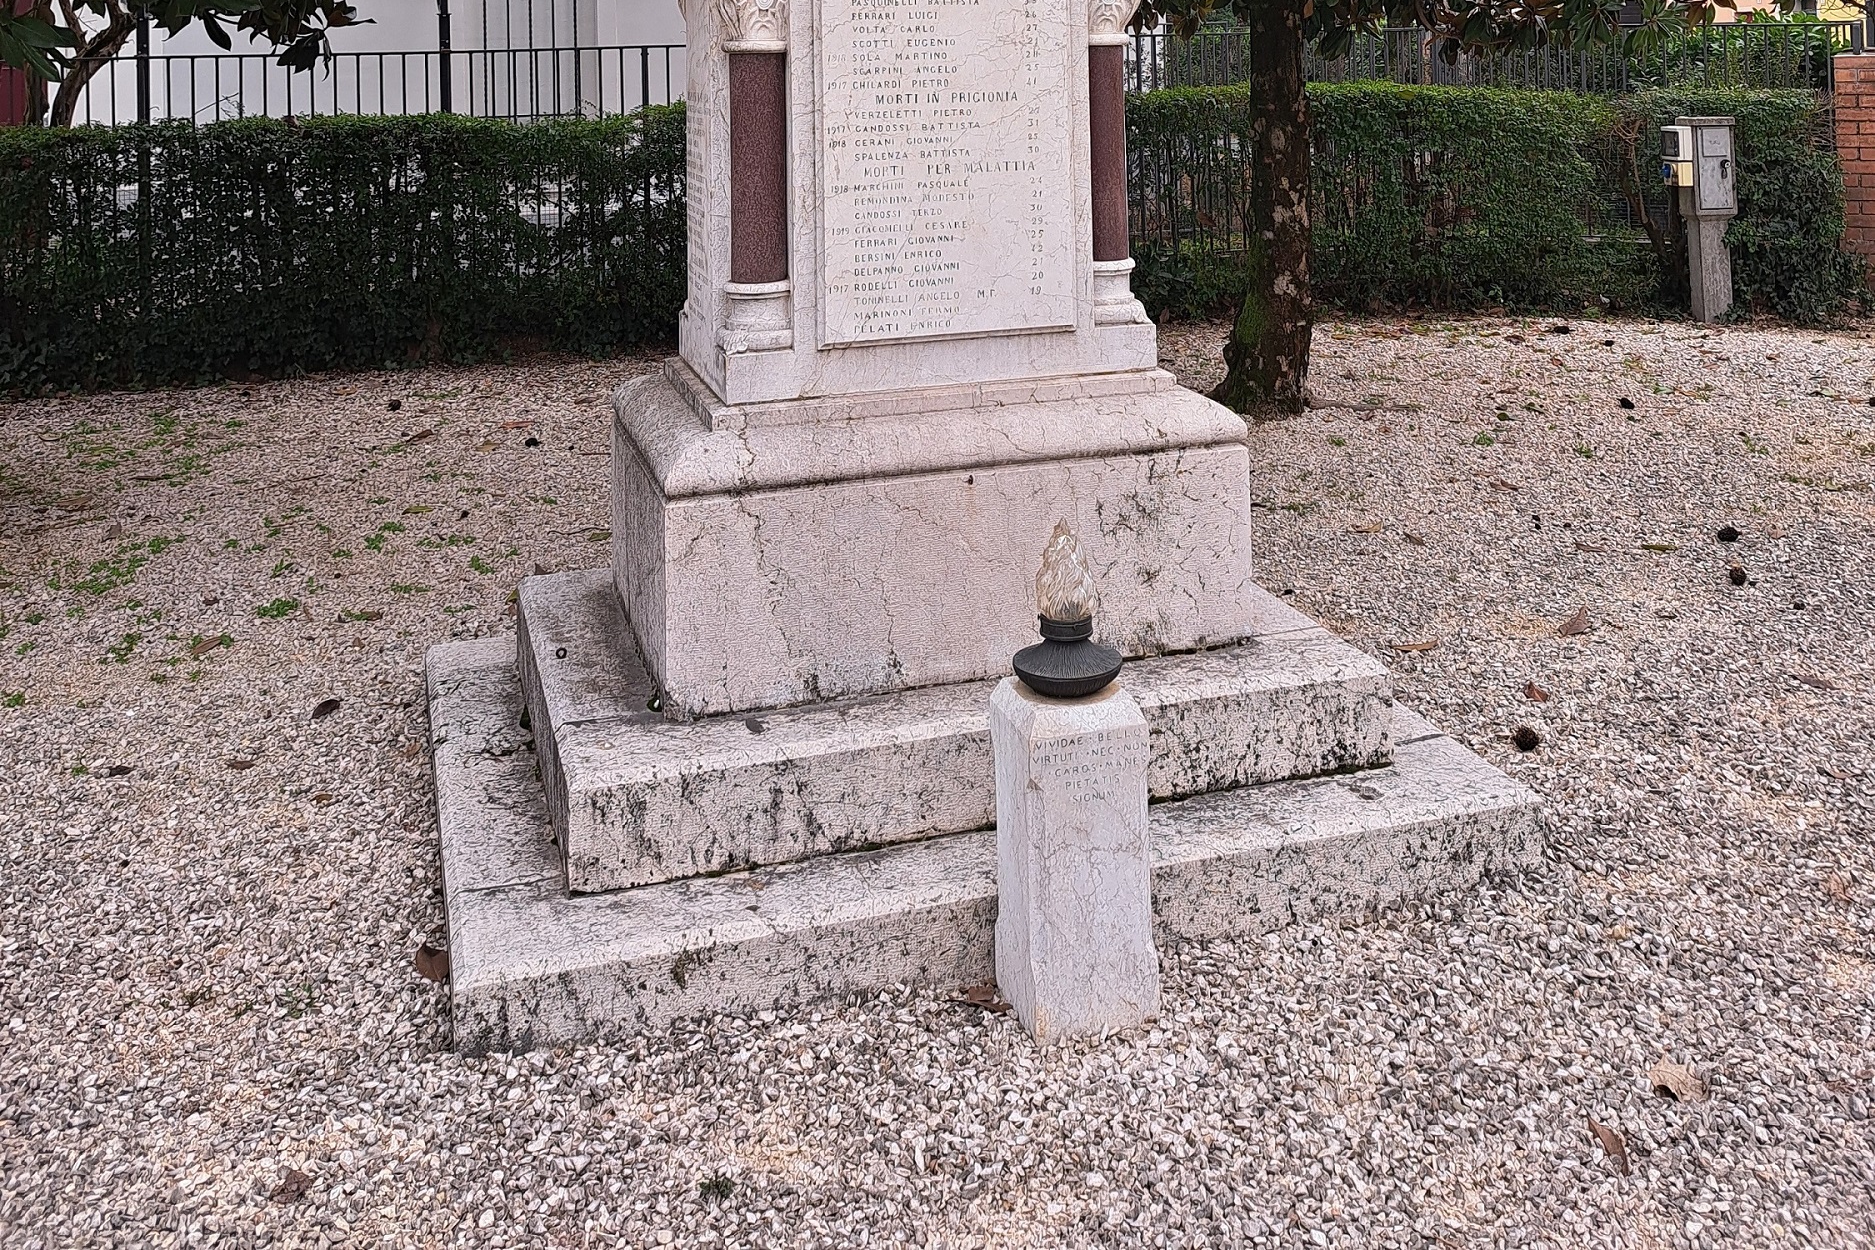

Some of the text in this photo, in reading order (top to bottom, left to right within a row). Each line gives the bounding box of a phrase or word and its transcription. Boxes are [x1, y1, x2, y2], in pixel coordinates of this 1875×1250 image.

[851, 12, 896, 21] FERRARI
[908, 11, 938, 20] LUIGI
[852, 26, 886, 34] VOLTA
[900, 25, 935, 33] CARLO
[852, 39, 893, 48] SCOTTI
[852, 53, 881, 62] SOLA
[895, 52, 947, 61] MARTINO
[828, 82, 847, 90] 1917
[912, 79, 949, 88] PIETRO
[875, 91, 1018, 105] MORTI IN PRIGIONIA
[854, 110, 922, 119] VERZELETTI
[933, 109, 972, 117] PIETRO
[921, 122, 981, 131] BATTISTA
[906, 136, 953, 145] GIOVANNI
[855, 151, 908, 162] SPALENZA
[920, 149, 970, 159] BATTISTA
[864, 165, 904, 178] MORTI
[964, 160, 1035, 173] MALATTIA
[853, 183, 904, 192] MARCHINI
[917, 180, 969, 190] PASQUALE
[854, 196, 913, 206] REMONDINA
[922, 193, 975, 202] MODESTO
[911, 208, 943, 217] TERZO
[925, 221, 967, 230] CESARE
[854, 238, 897, 248] FERRARI
[854, 253, 895, 263] BERSINI
[904, 250, 942, 259] ENRICO
[854, 266, 904, 277] DELPANNO
[829, 285, 849, 294] 1917
[854, 281, 898, 292] RODELLI
[854, 294, 908, 306] TONINELLI
[853, 309, 912, 321] MARINONI
[910, 320, 951, 330] ENRICO
[1034, 729, 1141, 750] VIVIDAE BELLO
[1032, 742, 1148, 764] VIRTUTI NEC NON
[1065, 774, 1120, 790] PIETATIS
